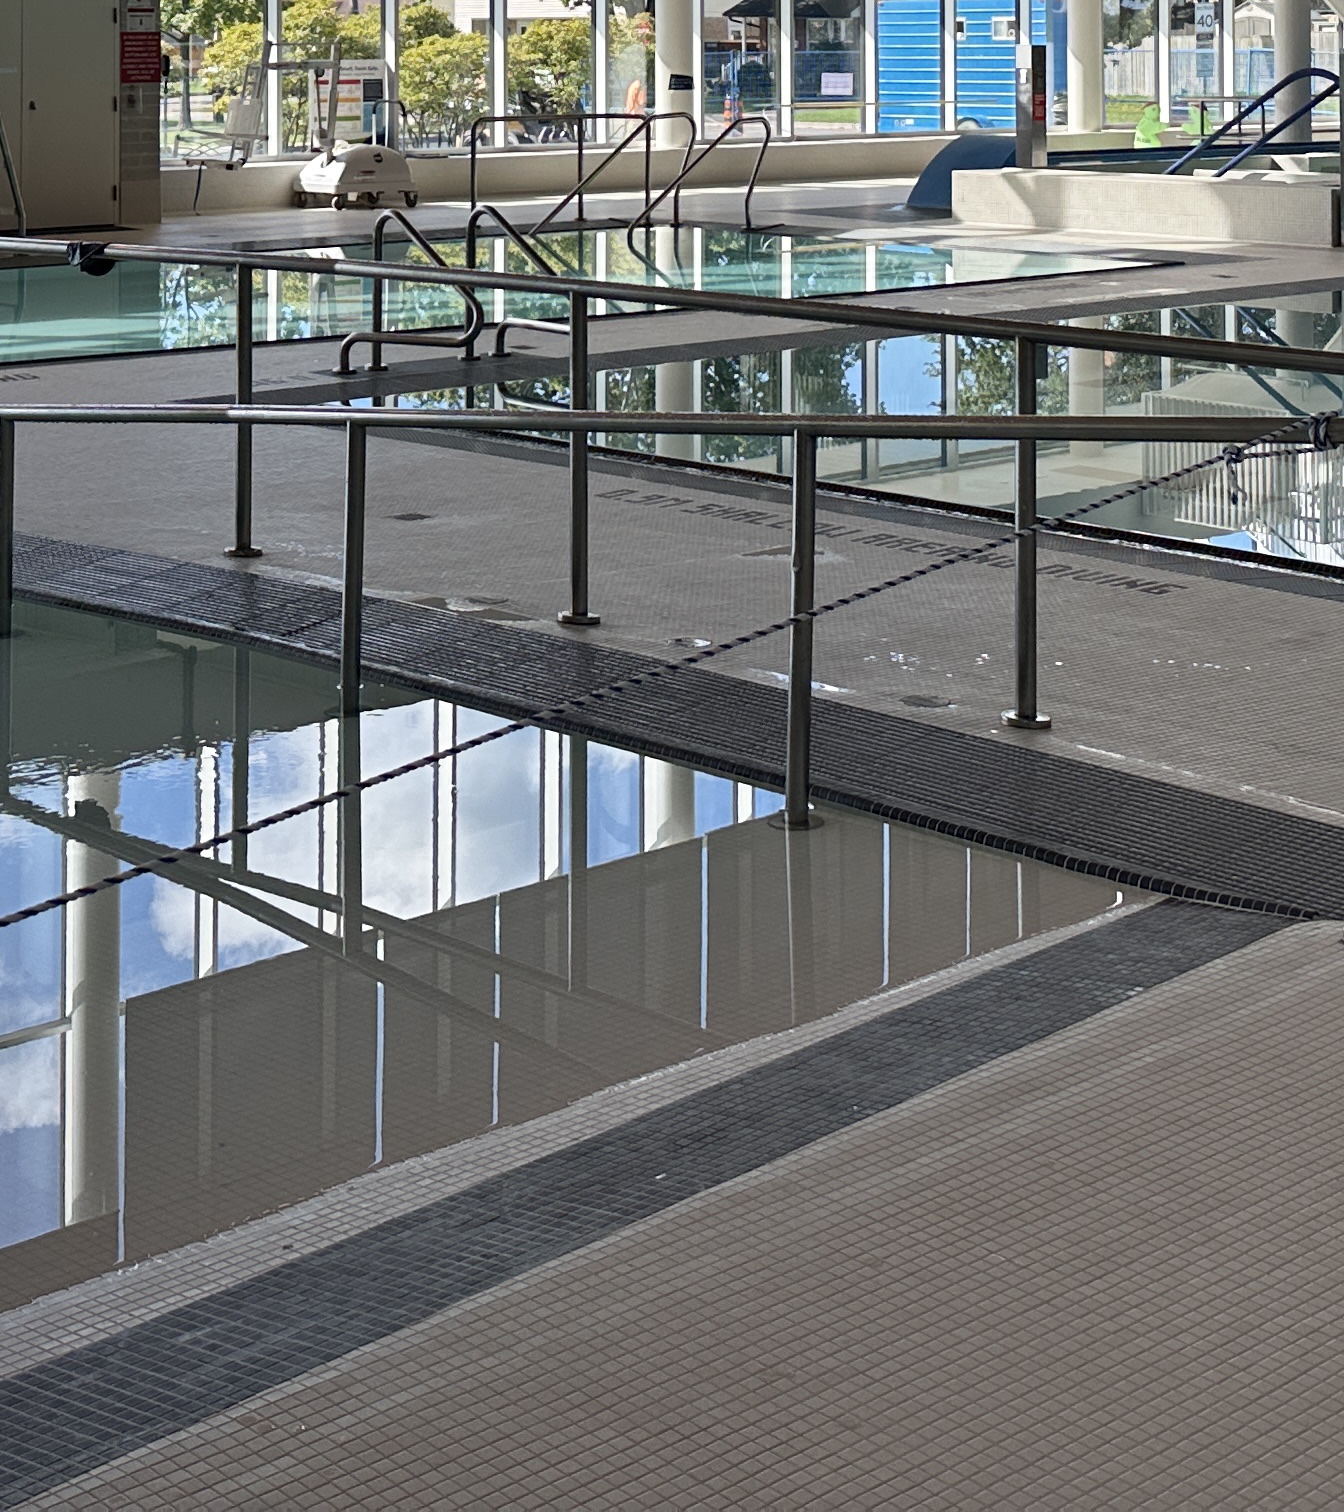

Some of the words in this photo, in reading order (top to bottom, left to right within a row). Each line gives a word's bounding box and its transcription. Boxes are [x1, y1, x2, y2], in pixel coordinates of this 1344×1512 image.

[1196, 14, 1213, 28] 40
[851, 533, 970, 557] AREA
[1036, 563, 1190, 595] DIVING
